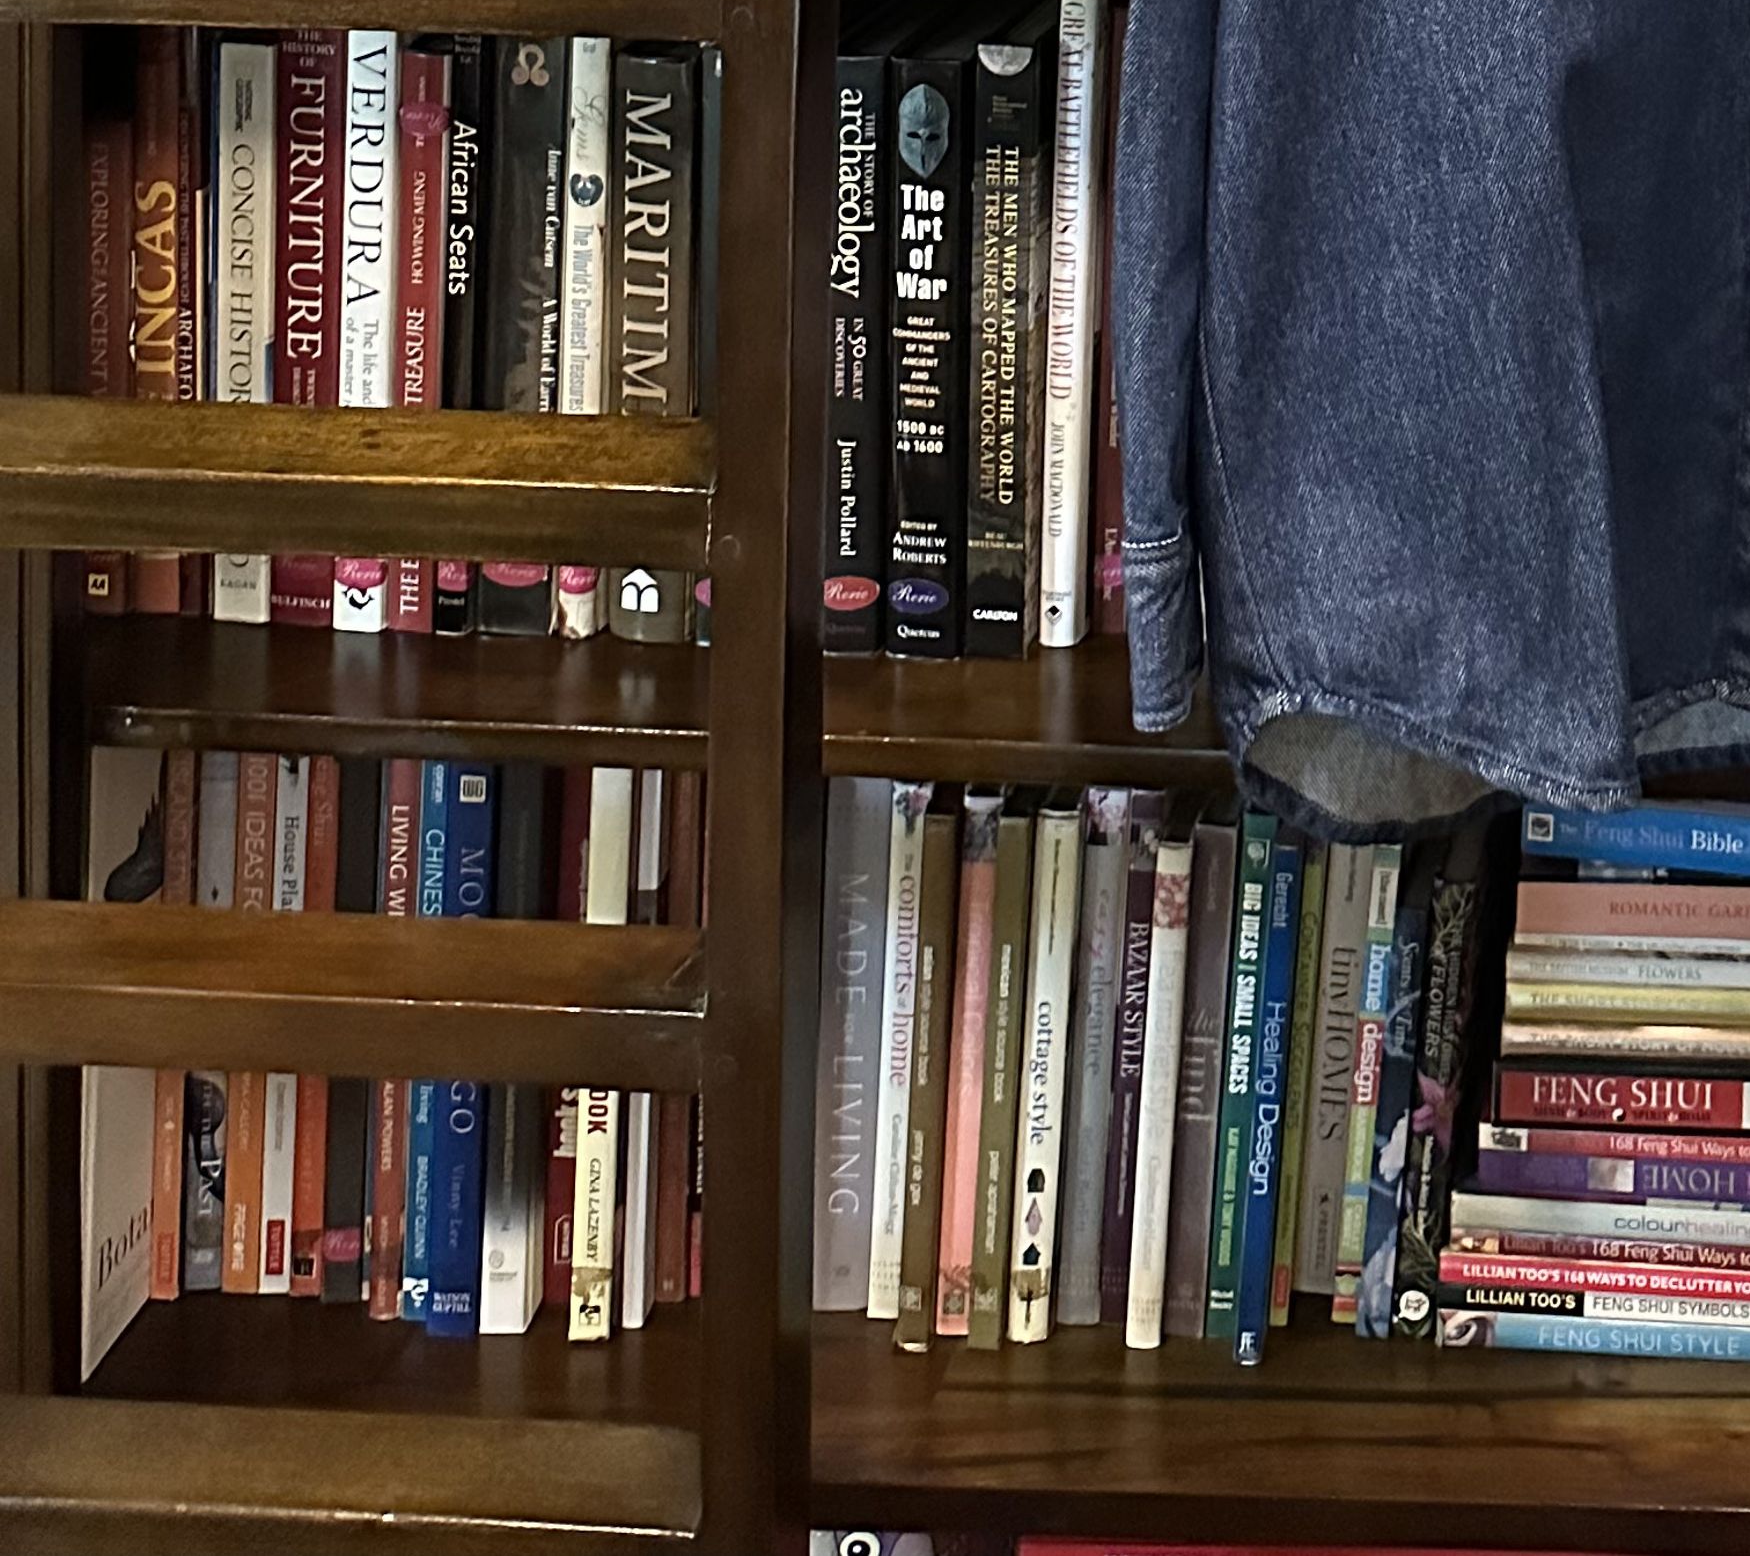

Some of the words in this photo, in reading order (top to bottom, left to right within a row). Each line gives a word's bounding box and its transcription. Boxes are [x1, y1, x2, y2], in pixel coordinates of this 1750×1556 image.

[345, 45, 388, 307] VERDURA
[450, 119, 479, 215] African
[829, 88, 876, 300] archaeology
[901, 183, 945, 212] The
[285, 73, 325, 361] FURNITURE
[901, 215, 943, 243] Art
[135, 179, 177, 379] INCAS
[447, 220, 473, 296] Seats
[896, 273, 948, 301] War
[909, 245, 934, 271] of
[892, 533, 948, 548] ANDREW
[892, 548, 948, 566] ROBERTS
[1690, 828, 1744, 857] Bible
[1030, 1001, 1056, 1090] cottage
[1254, 999, 1289, 1097] Healing
[1355, 1022, 1384, 1105] design
[1027, 1093, 1054, 1148] style
[1531, 1077, 1617, 1109] FENG
[1629, 1079, 1713, 1111] SHUI
[1247, 1101, 1282, 1196] Design
[1466, 1289, 1522, 1307] LILLIAN
